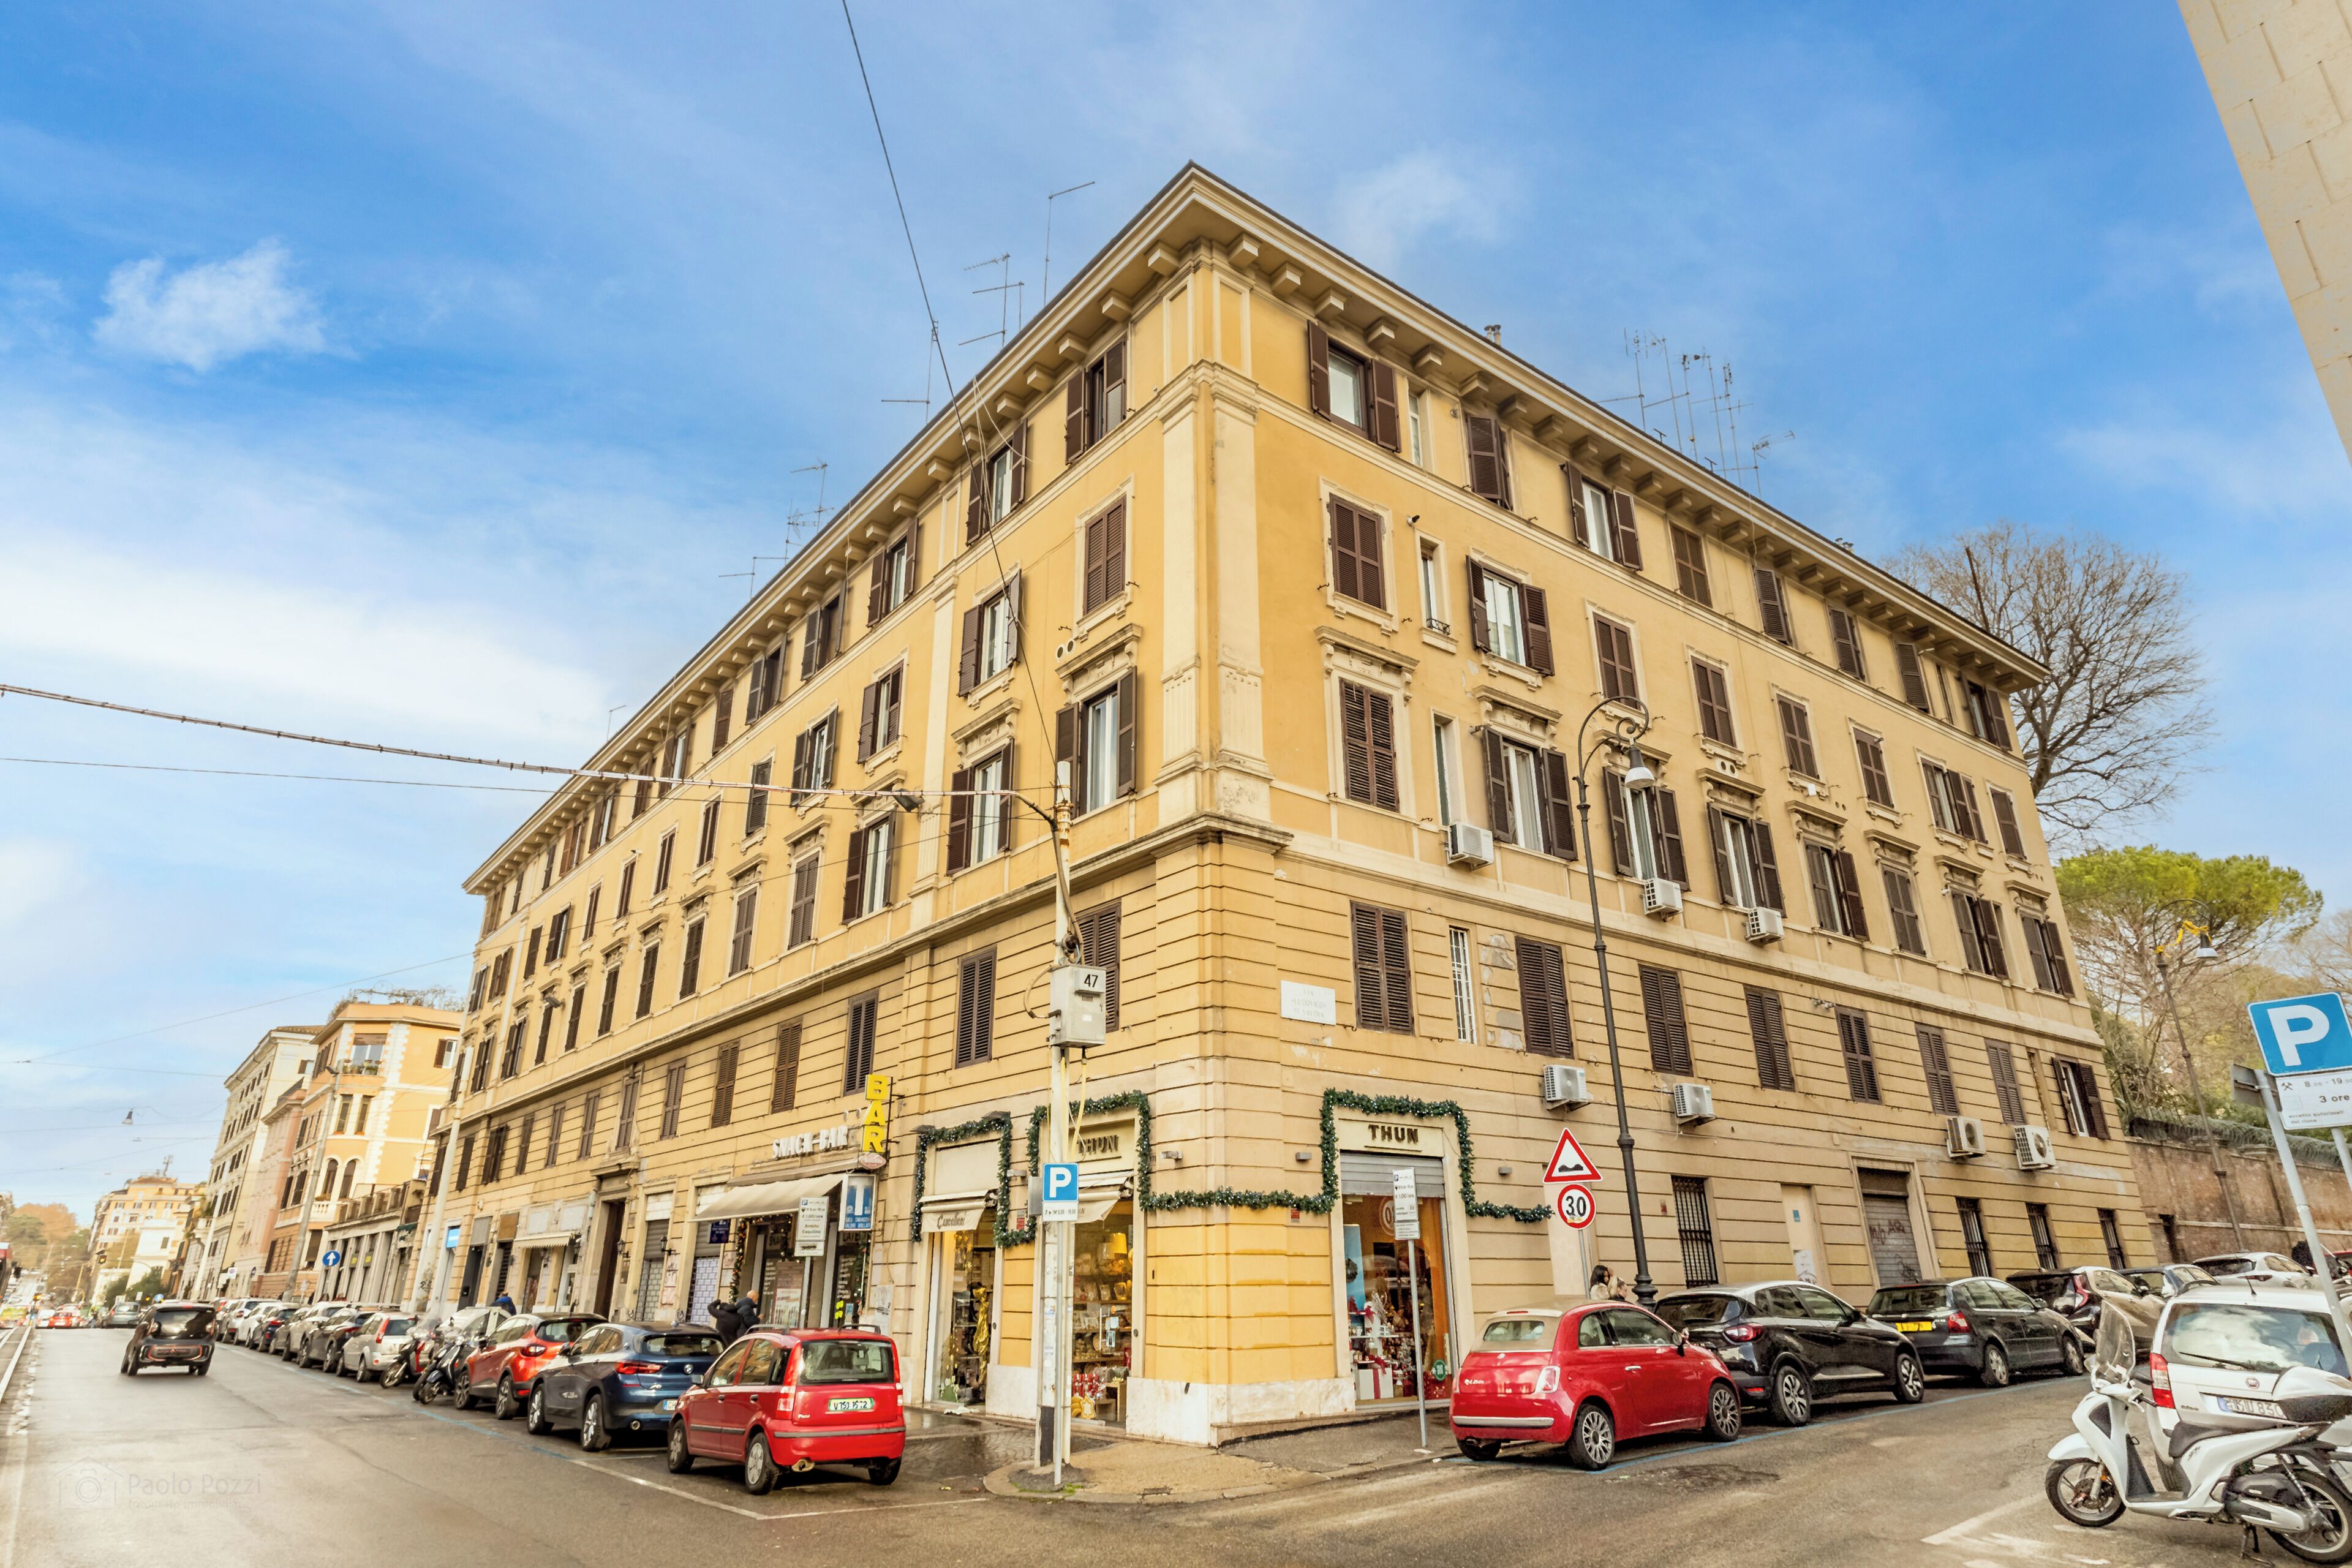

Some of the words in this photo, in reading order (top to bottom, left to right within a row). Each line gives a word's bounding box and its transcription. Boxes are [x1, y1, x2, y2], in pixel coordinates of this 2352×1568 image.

[1084, 974, 1098, 987] 47
[2267, 1005, 2330, 1067] P
[862, 1074, 889, 1153] BAR
[1077, 1134, 1119, 1155] THUN
[1368, 1124, 1419, 1144] THUN
[1049, 1167, 1072, 1198] P
[1566, 1196, 1586, 1217] 30
